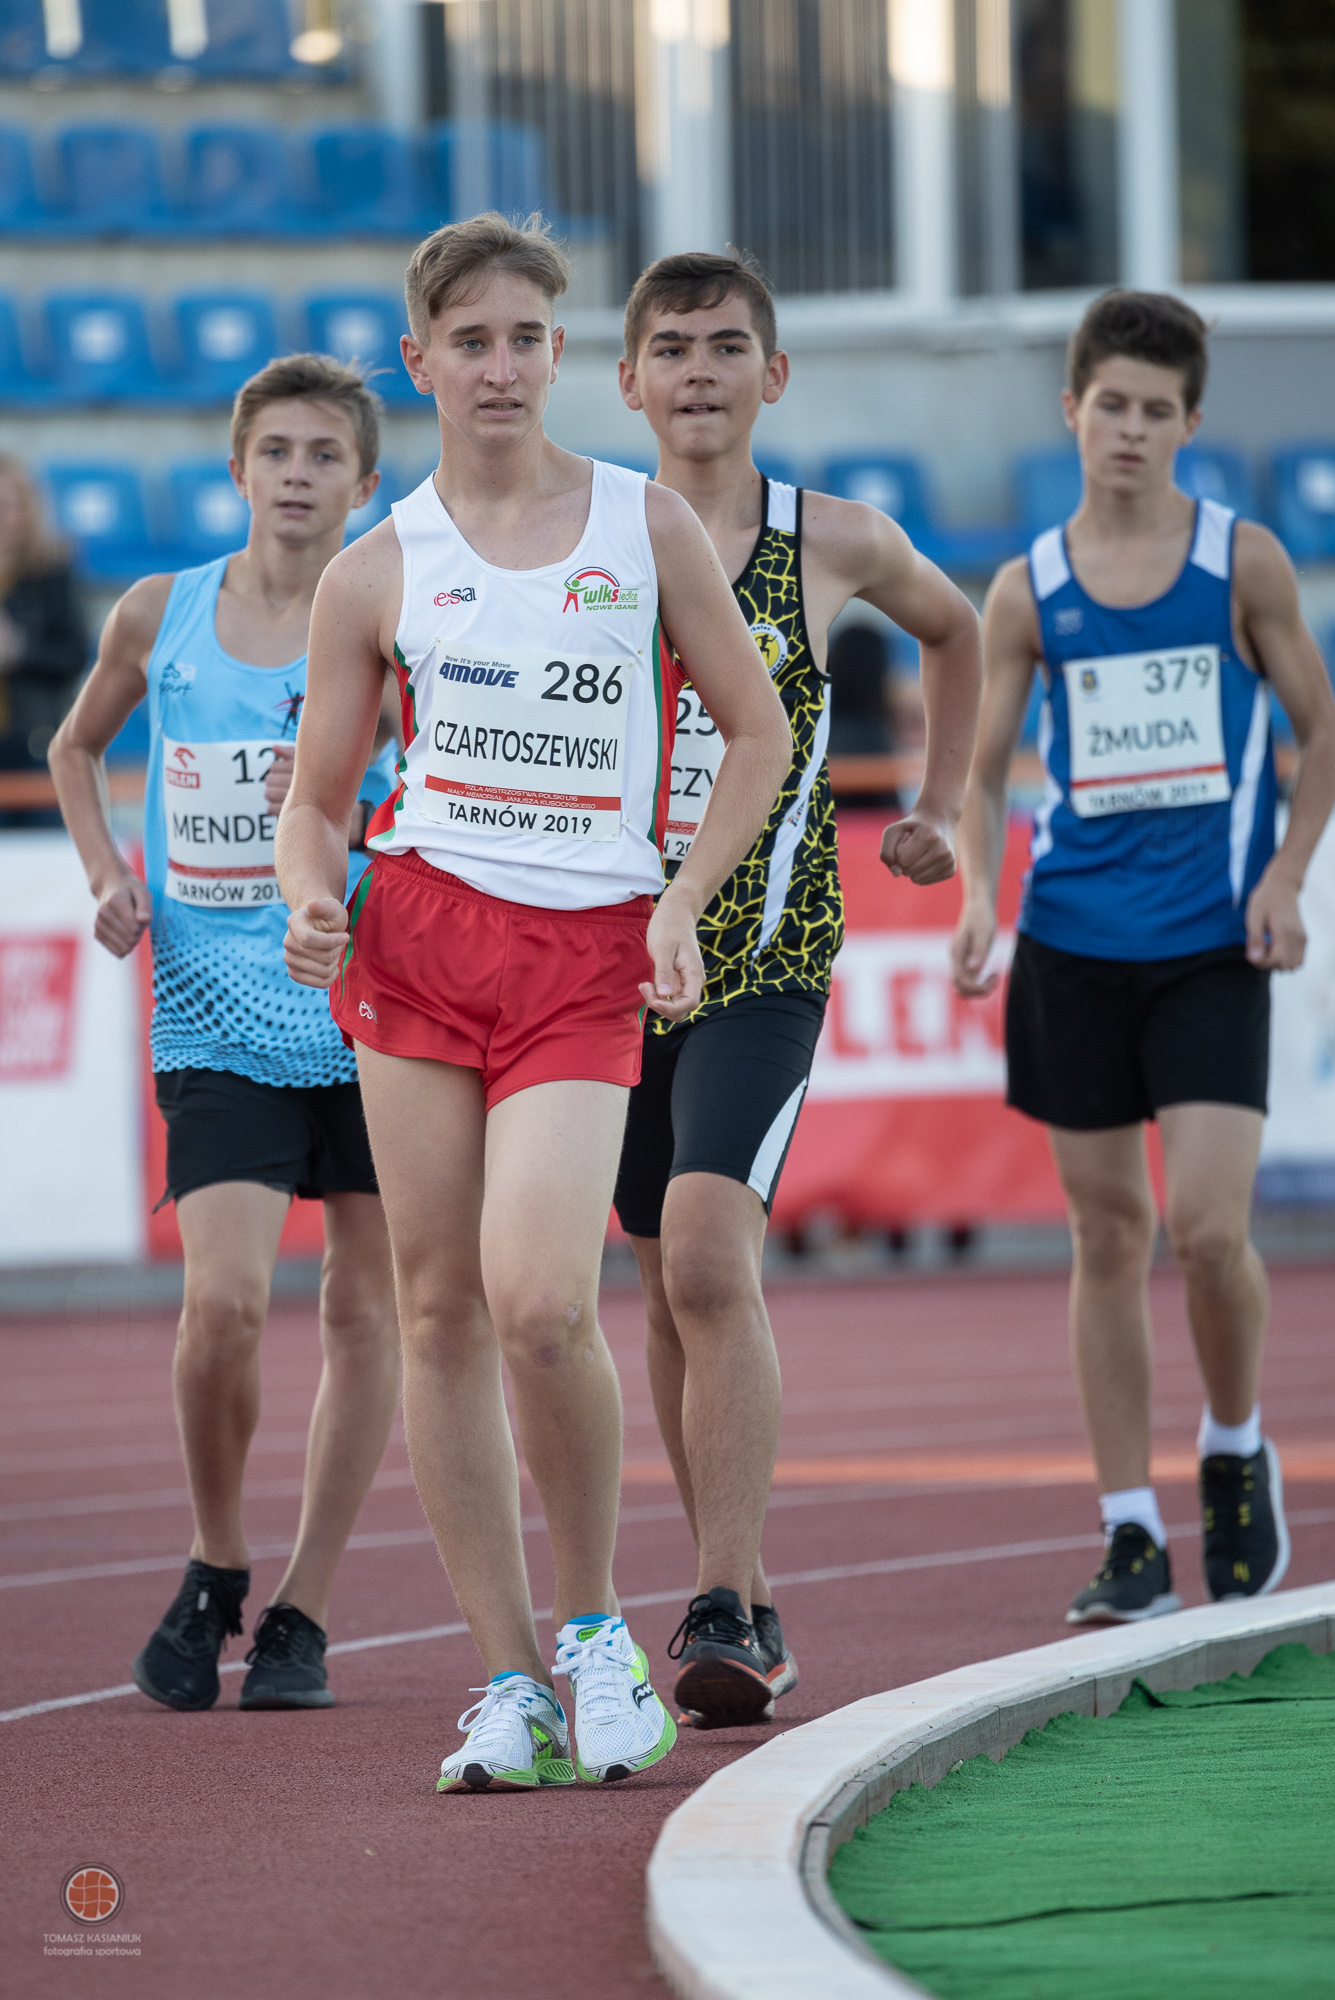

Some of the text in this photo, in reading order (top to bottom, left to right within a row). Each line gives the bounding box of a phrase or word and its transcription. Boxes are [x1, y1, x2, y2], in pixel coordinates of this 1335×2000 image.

[439, 661, 519, 688] 4MOVE
[445, 655, 459, 663] Now
[459, 657, 471, 665] It's
[492, 661, 511, 669] Move
[1143, 654, 1214, 695] 379
[541, 660, 623, 705] 286
[434, 719, 618, 770] CZARTOSZEWSKI
[1087, 717, 1198, 757] ŻMUDA
[464, 784, 483, 792] PZLA
[484, 786, 537, 799] MISTRZOSTWA
[538, 791, 565, 801] POLSKI
[504, 796, 539, 805] JANUSZA
[172, 812, 279, 844] MENDE
[448, 802, 592, 835] TARNÓW 2019
[177, 882, 245, 902] TARNÓW
